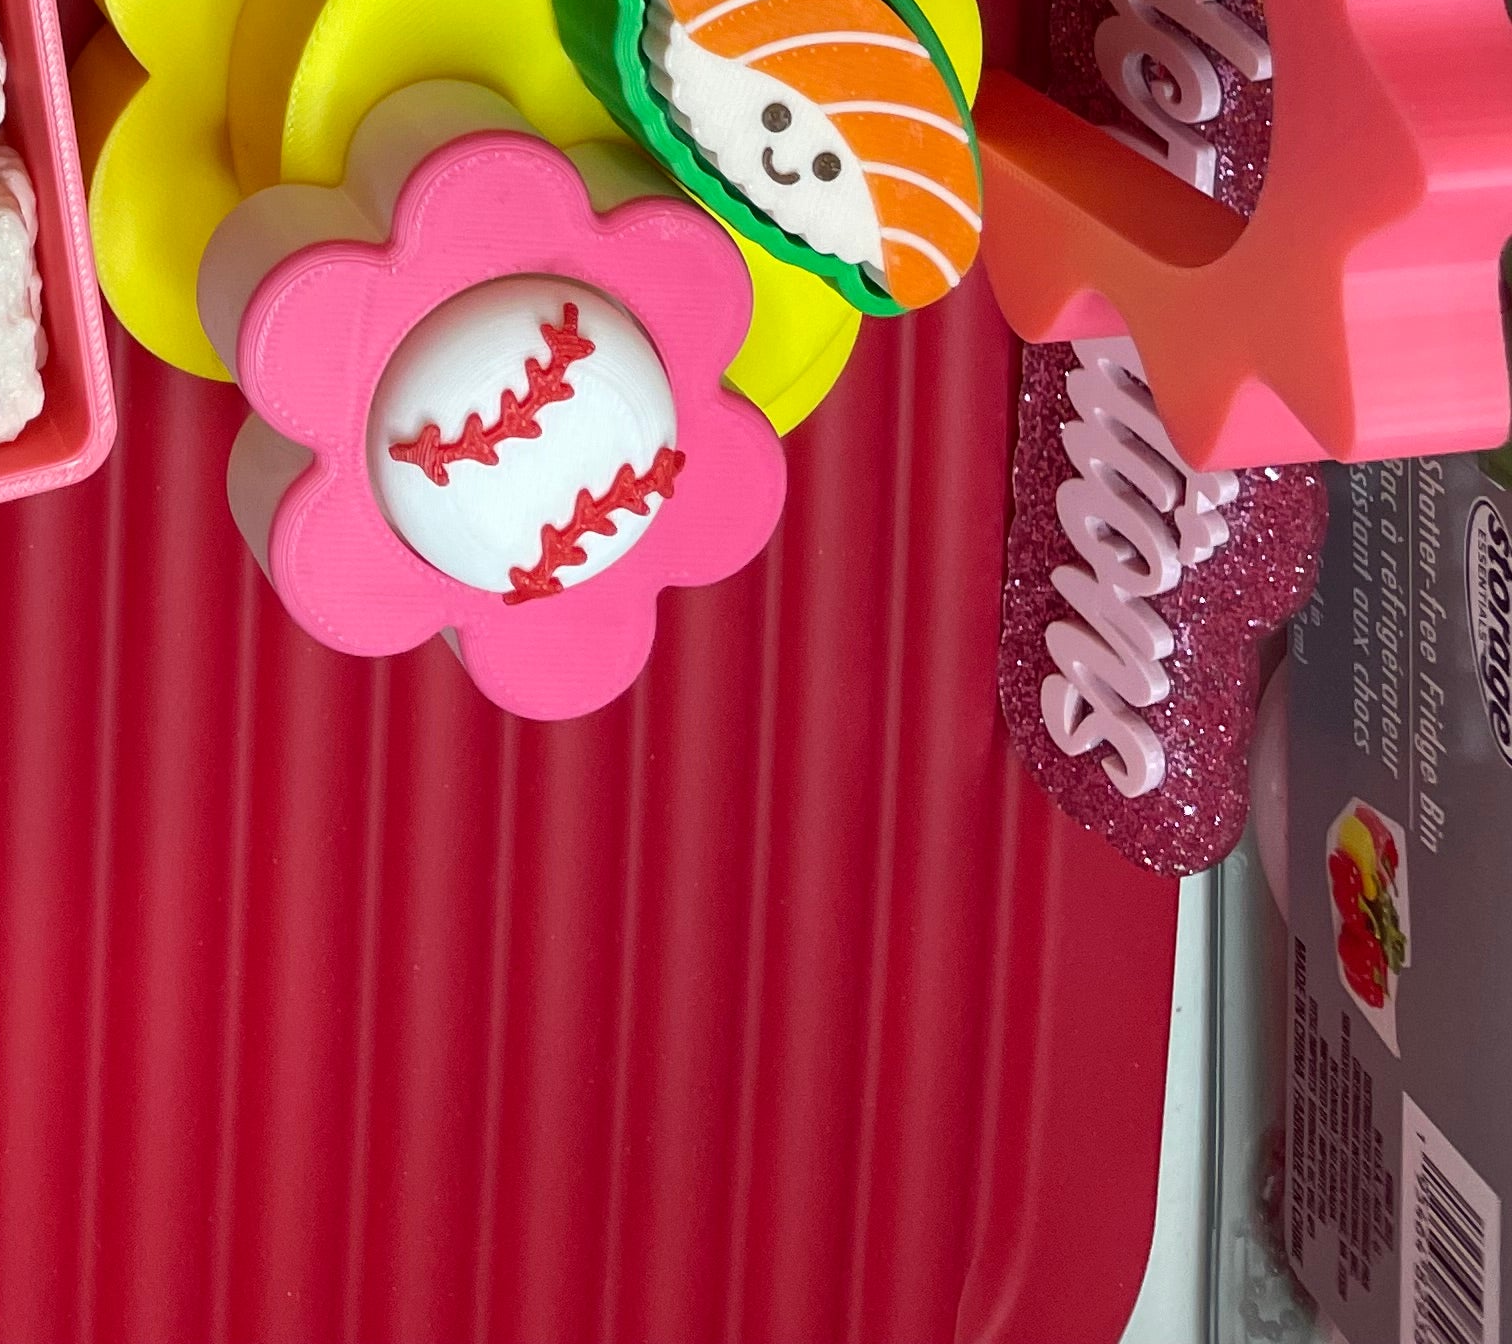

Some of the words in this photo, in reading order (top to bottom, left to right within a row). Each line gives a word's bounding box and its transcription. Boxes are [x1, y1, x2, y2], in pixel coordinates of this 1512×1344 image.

[1349, 462, 1375, 582] sistant
[1381, 518, 1406, 544] à
[1417, 457, 1446, 664] Shatter-free
[1352, 586, 1371, 655] aux
[1477, 528, 1488, 642] ESSENTIALS
[1481, 513, 1512, 746] storage
[1352, 662, 1378, 755] chocs
[1375, 551, 1407, 779] réfrigérateur
[1414, 672, 1446, 784] Fridge
[1419, 792, 1446, 853] Bin
